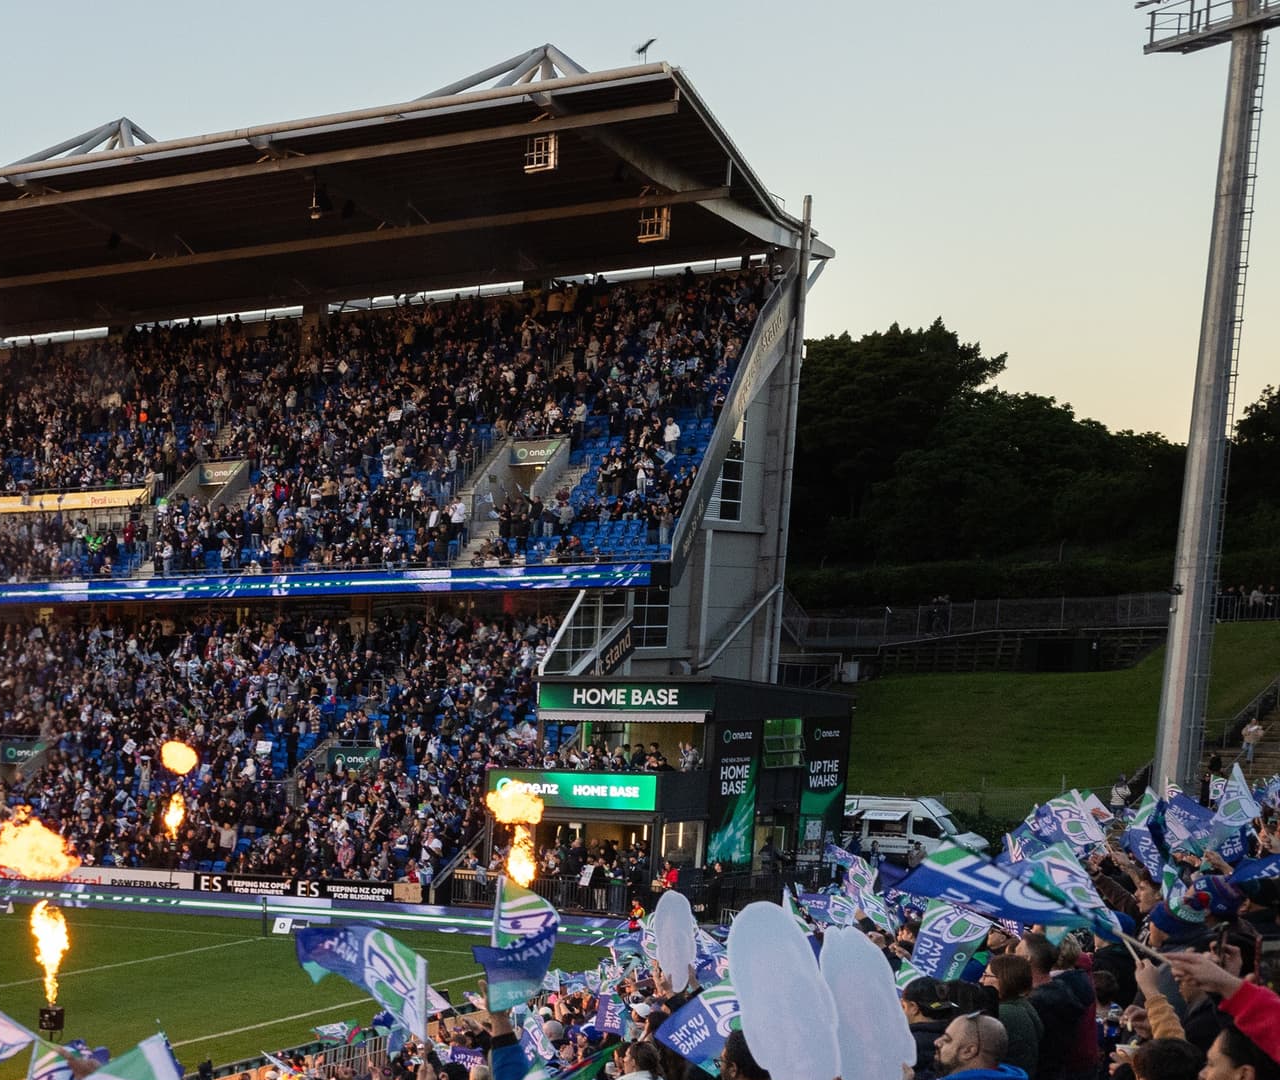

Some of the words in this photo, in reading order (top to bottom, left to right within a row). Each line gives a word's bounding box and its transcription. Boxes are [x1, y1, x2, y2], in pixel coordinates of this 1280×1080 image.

[573, 688, 626, 705] HOME
[631, 688, 679, 705] BASE
[732, 730, 752, 739] one.nz
[720, 765, 750, 780] HOME
[810, 761, 822, 773] UP
[822, 760, 839, 772] THE
[809, 775, 838, 787] WAHS!
[573, 784, 608, 797] HOME
[609, 785, 639, 798] BASE
[721, 781, 747, 795] BASE
[227, 880, 258, 888] KEEPING
[271, 882, 290, 890] OPEN
[327, 885, 359, 893] KEEPING
[373, 887, 392, 895] OPEN
